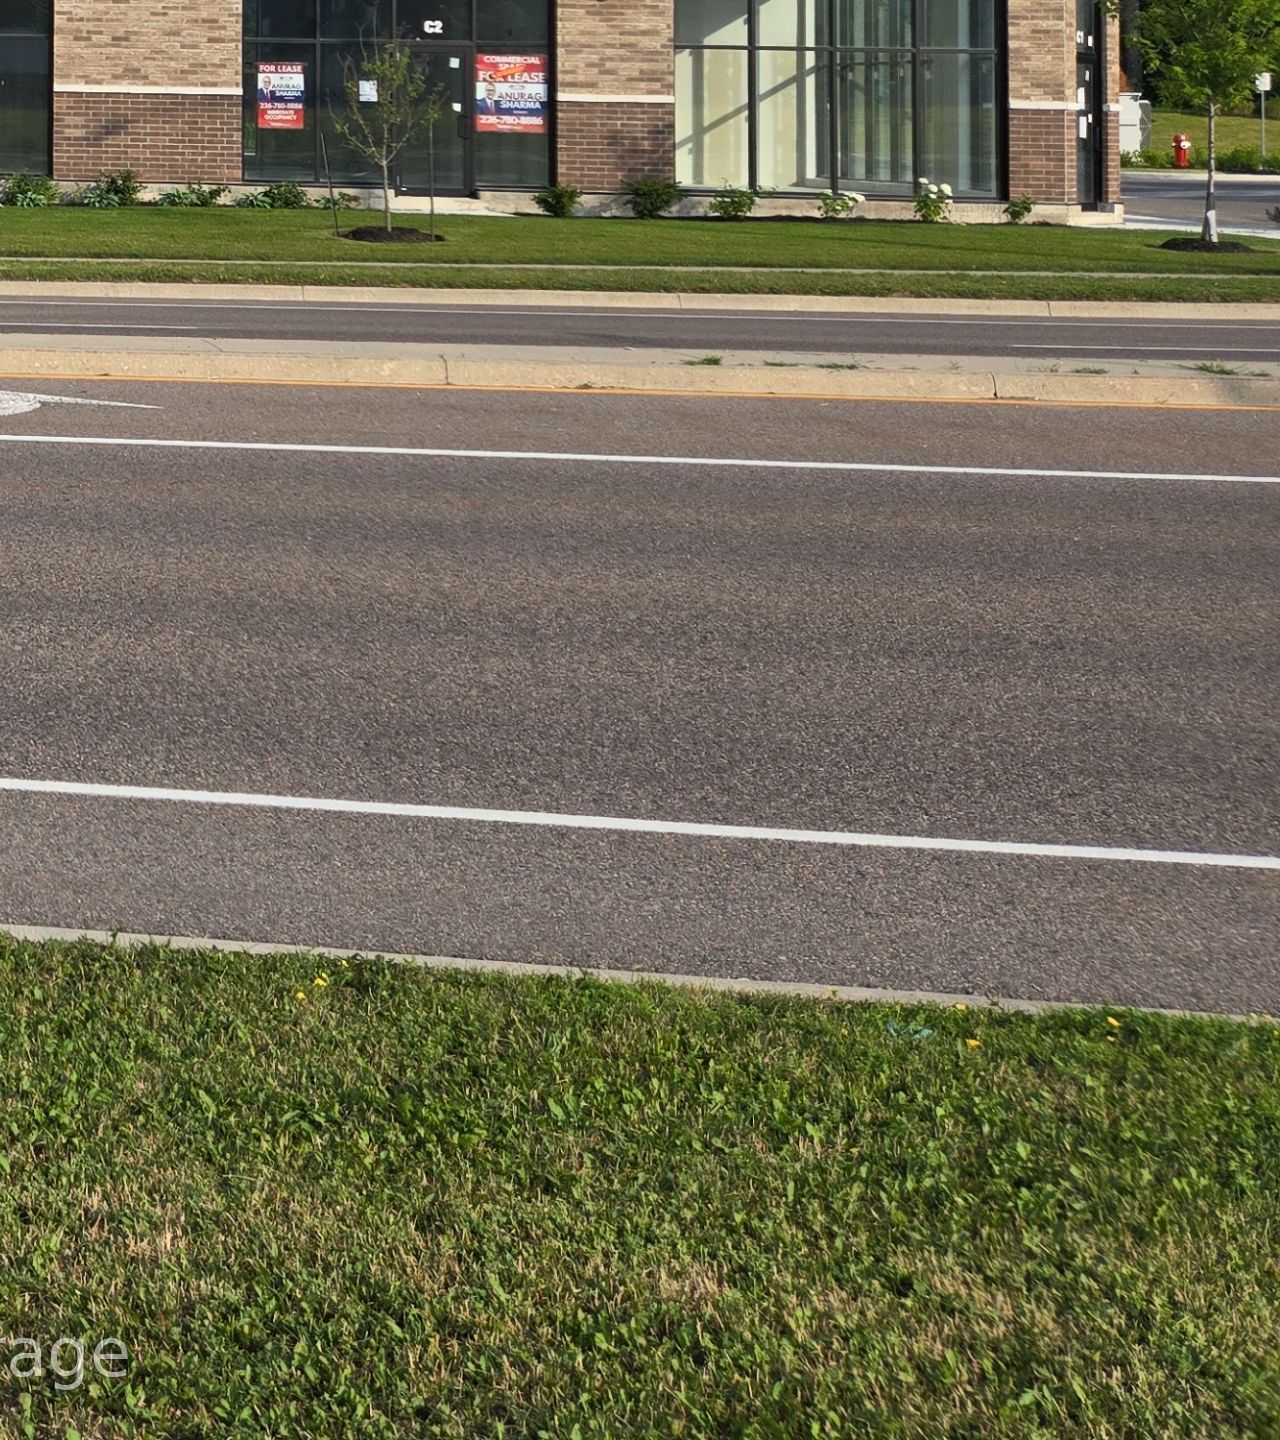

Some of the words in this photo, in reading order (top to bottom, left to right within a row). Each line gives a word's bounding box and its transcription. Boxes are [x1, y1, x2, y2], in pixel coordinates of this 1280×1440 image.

[423, 20, 443, 34] C2
[483, 55, 541, 64] COMMERCIAL
[259, 64, 276, 72] FOR
[277, 64, 303, 73] LEASE
[507, 72, 545, 82] LEASE
[497, 92, 542, 101] ANURAG
[500, 101, 542, 109] SHARMA
